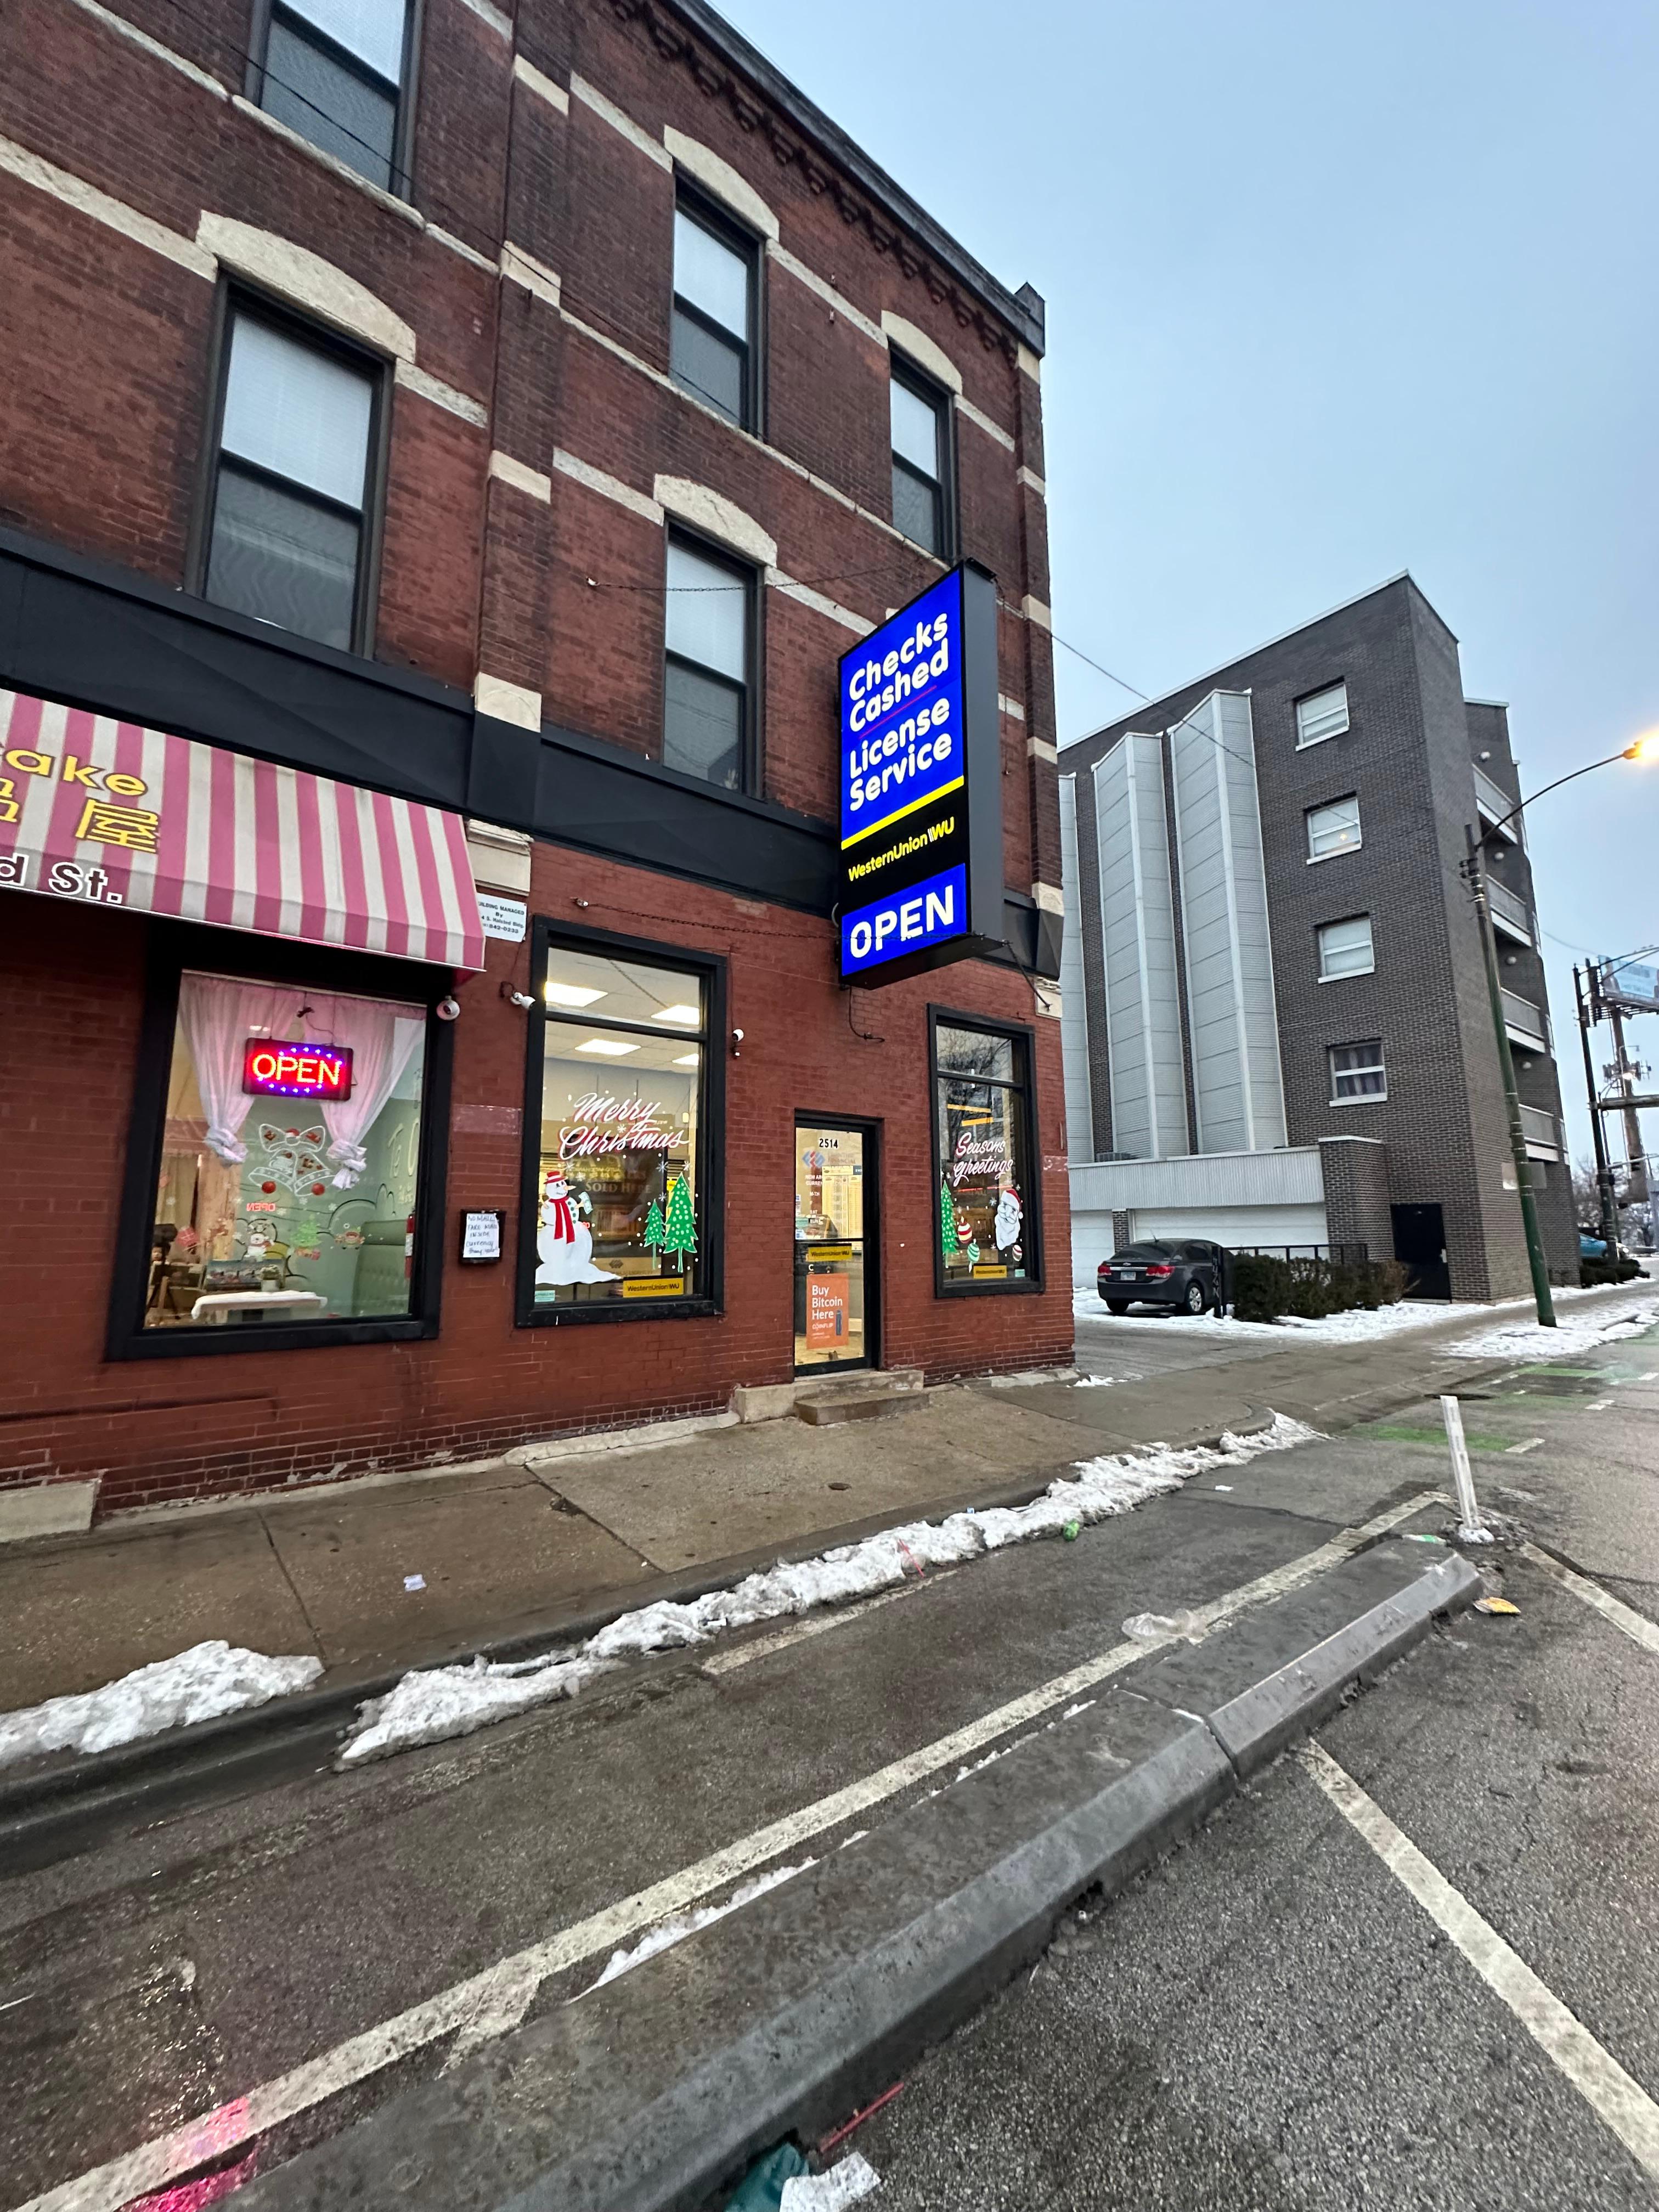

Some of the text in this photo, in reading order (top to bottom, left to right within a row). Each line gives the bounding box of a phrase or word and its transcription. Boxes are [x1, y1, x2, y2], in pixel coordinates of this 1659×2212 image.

[850, 613, 947, 701] Checks
[850, 637, 949, 732] Cashed
[850, 698, 950, 779] License
[0, 744, 148, 796] ake
[850, 733, 952, 811] Service
[0, 852, 122, 904] d St.
[478, 901, 525, 916] UILDING MANAGED
[850, 884, 954, 958] OPEN
[252, 1053, 341, 1086] OPEN
[573, 1092, 662, 1127] Merry
[559, 1124, 691, 1160] Christmas
[819, 1138, 838, 1149] 2514
[956, 1132, 1006, 1158] Seasons
[953, 1156, 1014, 1187] Greetings
[811, 1285, 830, 1297] Buy
[811, 1296, 843, 1308] Bitcoin
[811, 1310, 834, 1320] Here
